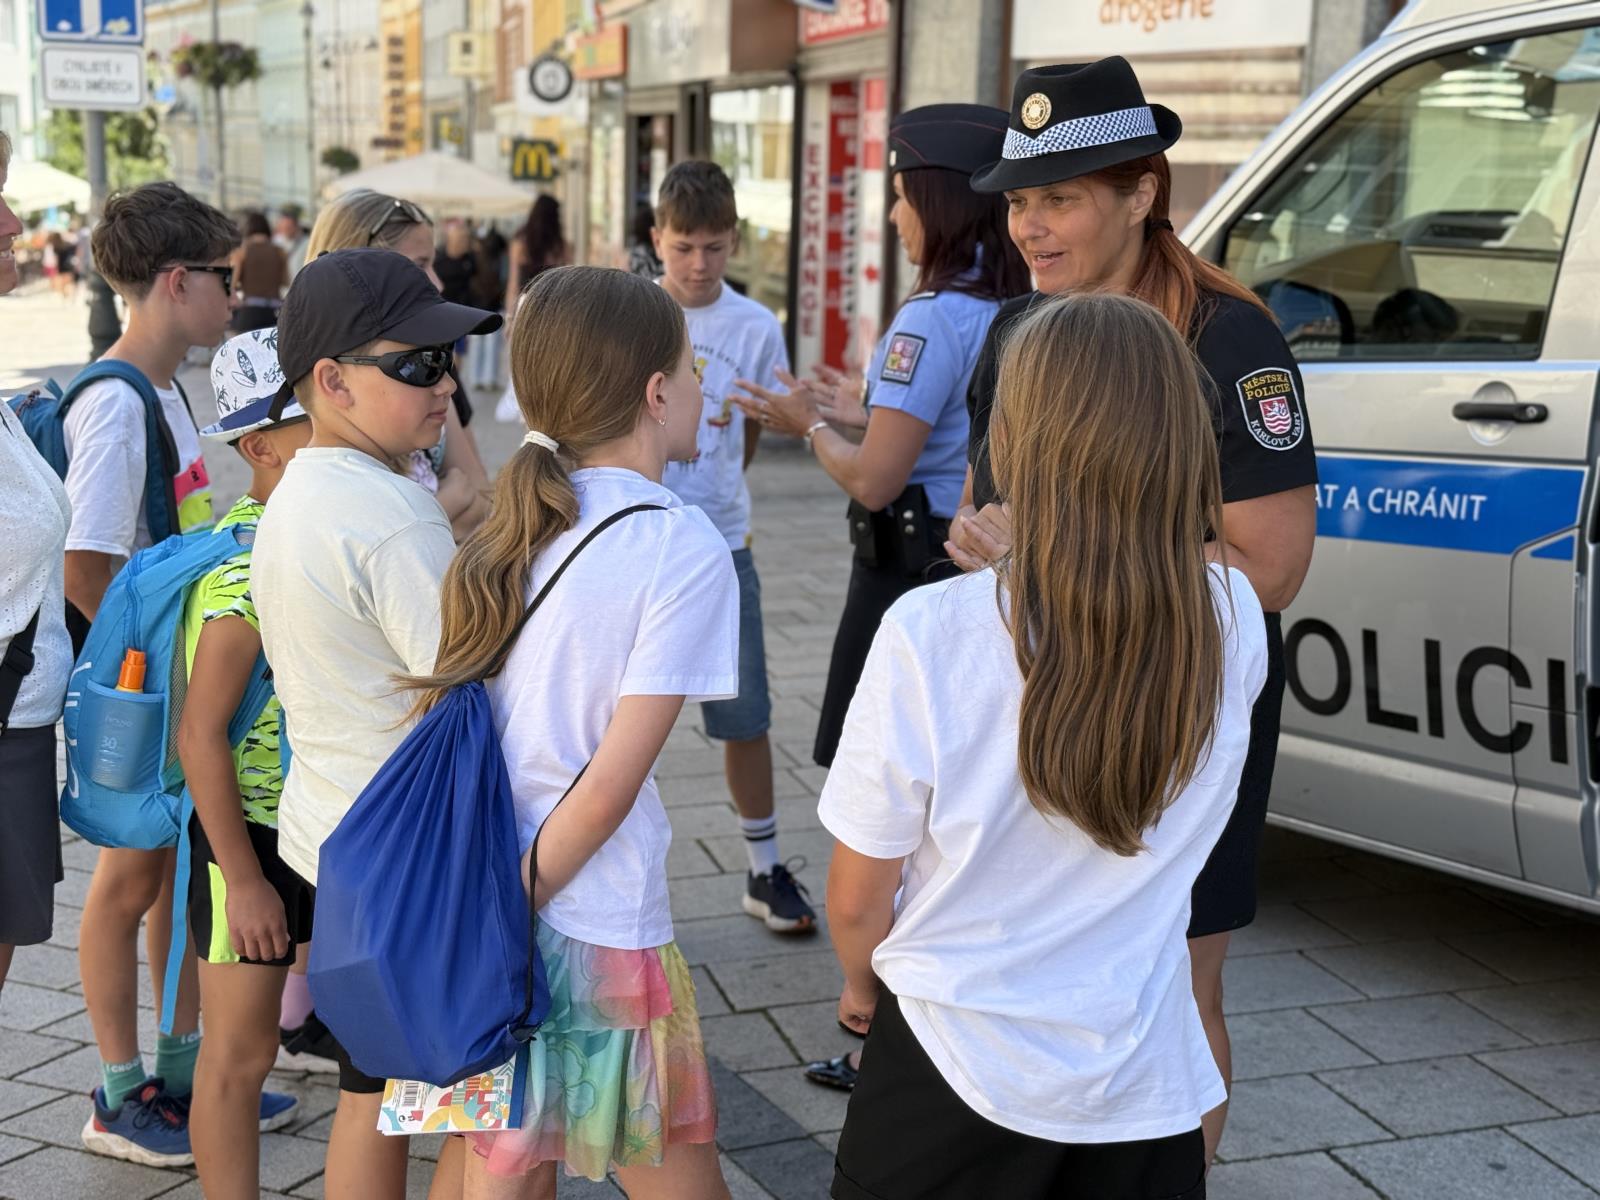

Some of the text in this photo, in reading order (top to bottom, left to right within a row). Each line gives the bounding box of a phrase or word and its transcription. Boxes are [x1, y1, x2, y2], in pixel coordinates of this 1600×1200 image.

[1098, 0, 1214, 32] drogerie
[802, 143, 820, 337] EXCHANGE
[1243, 373, 1289, 391] MĚSTSKÁ
[1246, 383, 1291, 400] POLICIE
[1250, 412, 1300, 446] KARLOVY VARY
[1342, 486, 1360, 511] A
[1367, 486, 1487, 522] CHRÁNIT
